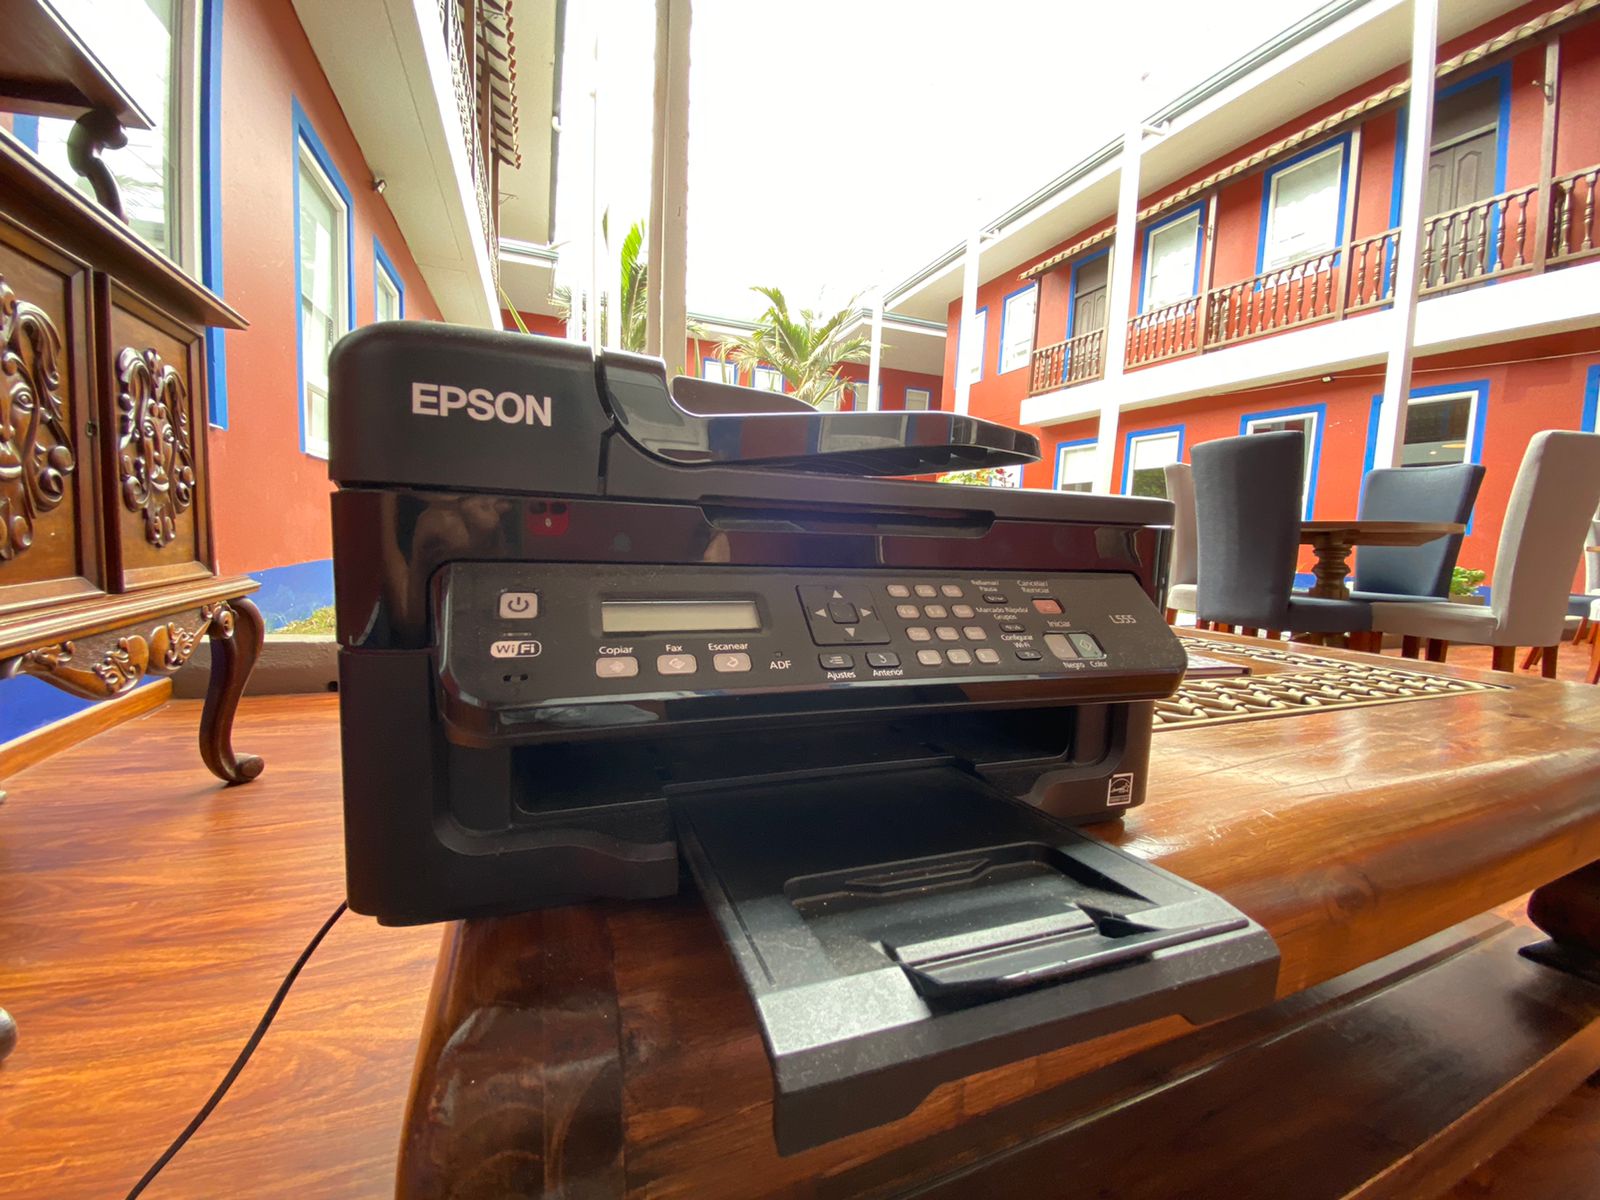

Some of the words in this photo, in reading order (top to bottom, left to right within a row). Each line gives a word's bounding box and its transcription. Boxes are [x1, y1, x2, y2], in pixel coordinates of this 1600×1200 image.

[412, 382, 552, 427] EPSON
[993, 613, 1018, 621] Grupos
[1108, 614, 1137, 624] L555
[1000, 633, 1034, 642] Configurar
[598, 645, 634, 656] Copiar
[665, 643, 684, 652] Fax
[707, 641, 749, 651] Escanear
[769, 659, 792, 670] ADF
[1062, 661, 1086, 670] Negro
[826, 671, 857, 680] Ajustes
[872, 668, 904, 677] Anterior
